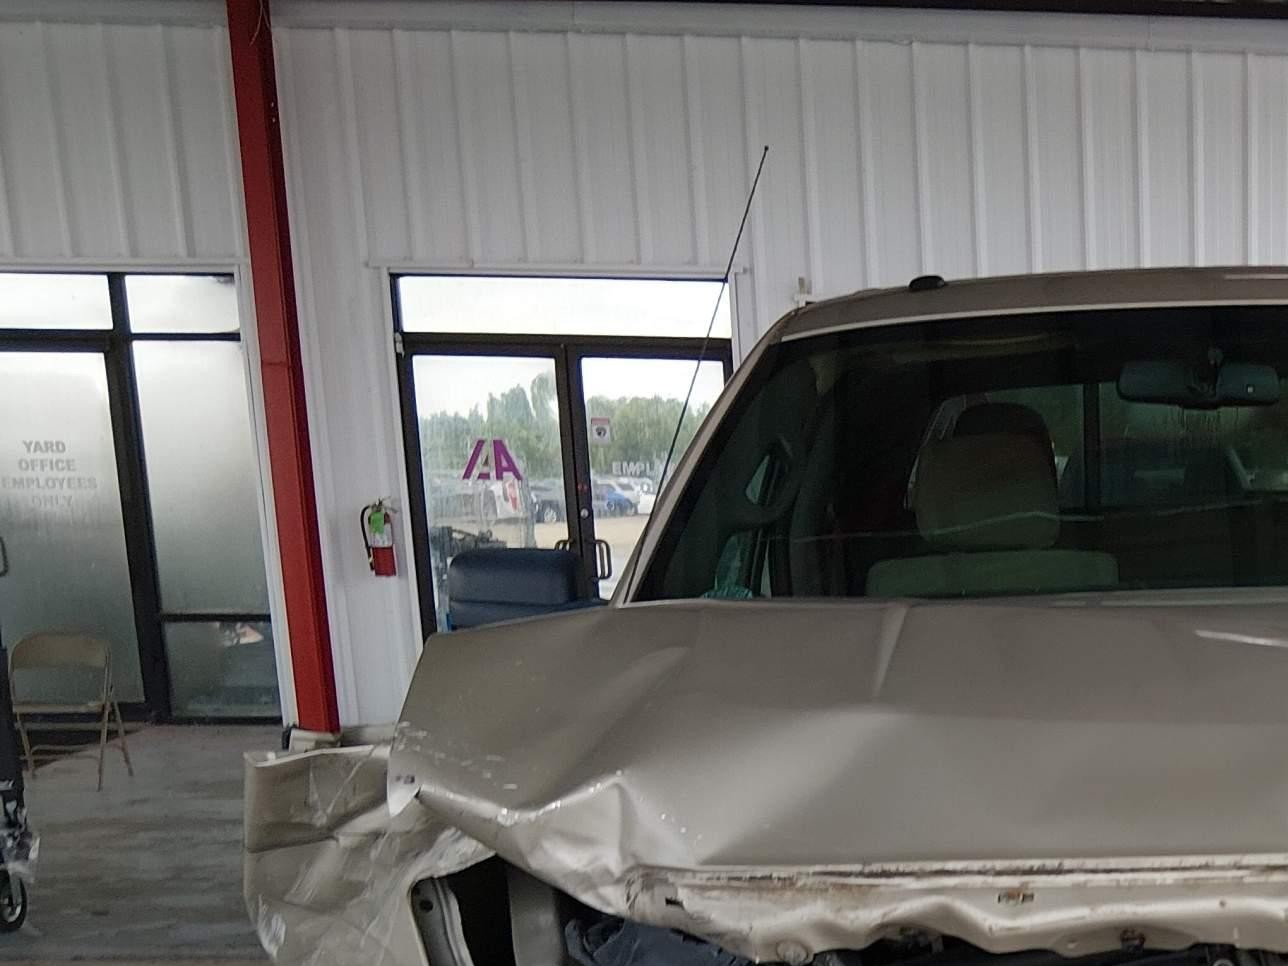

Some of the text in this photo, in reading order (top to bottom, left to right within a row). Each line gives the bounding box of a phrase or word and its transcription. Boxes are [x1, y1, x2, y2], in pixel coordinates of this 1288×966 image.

[22, 440, 66, 453] YARD
[18, 458, 76, 472] OFFICE
[0, 476, 98, 490] EMPLOYEES
